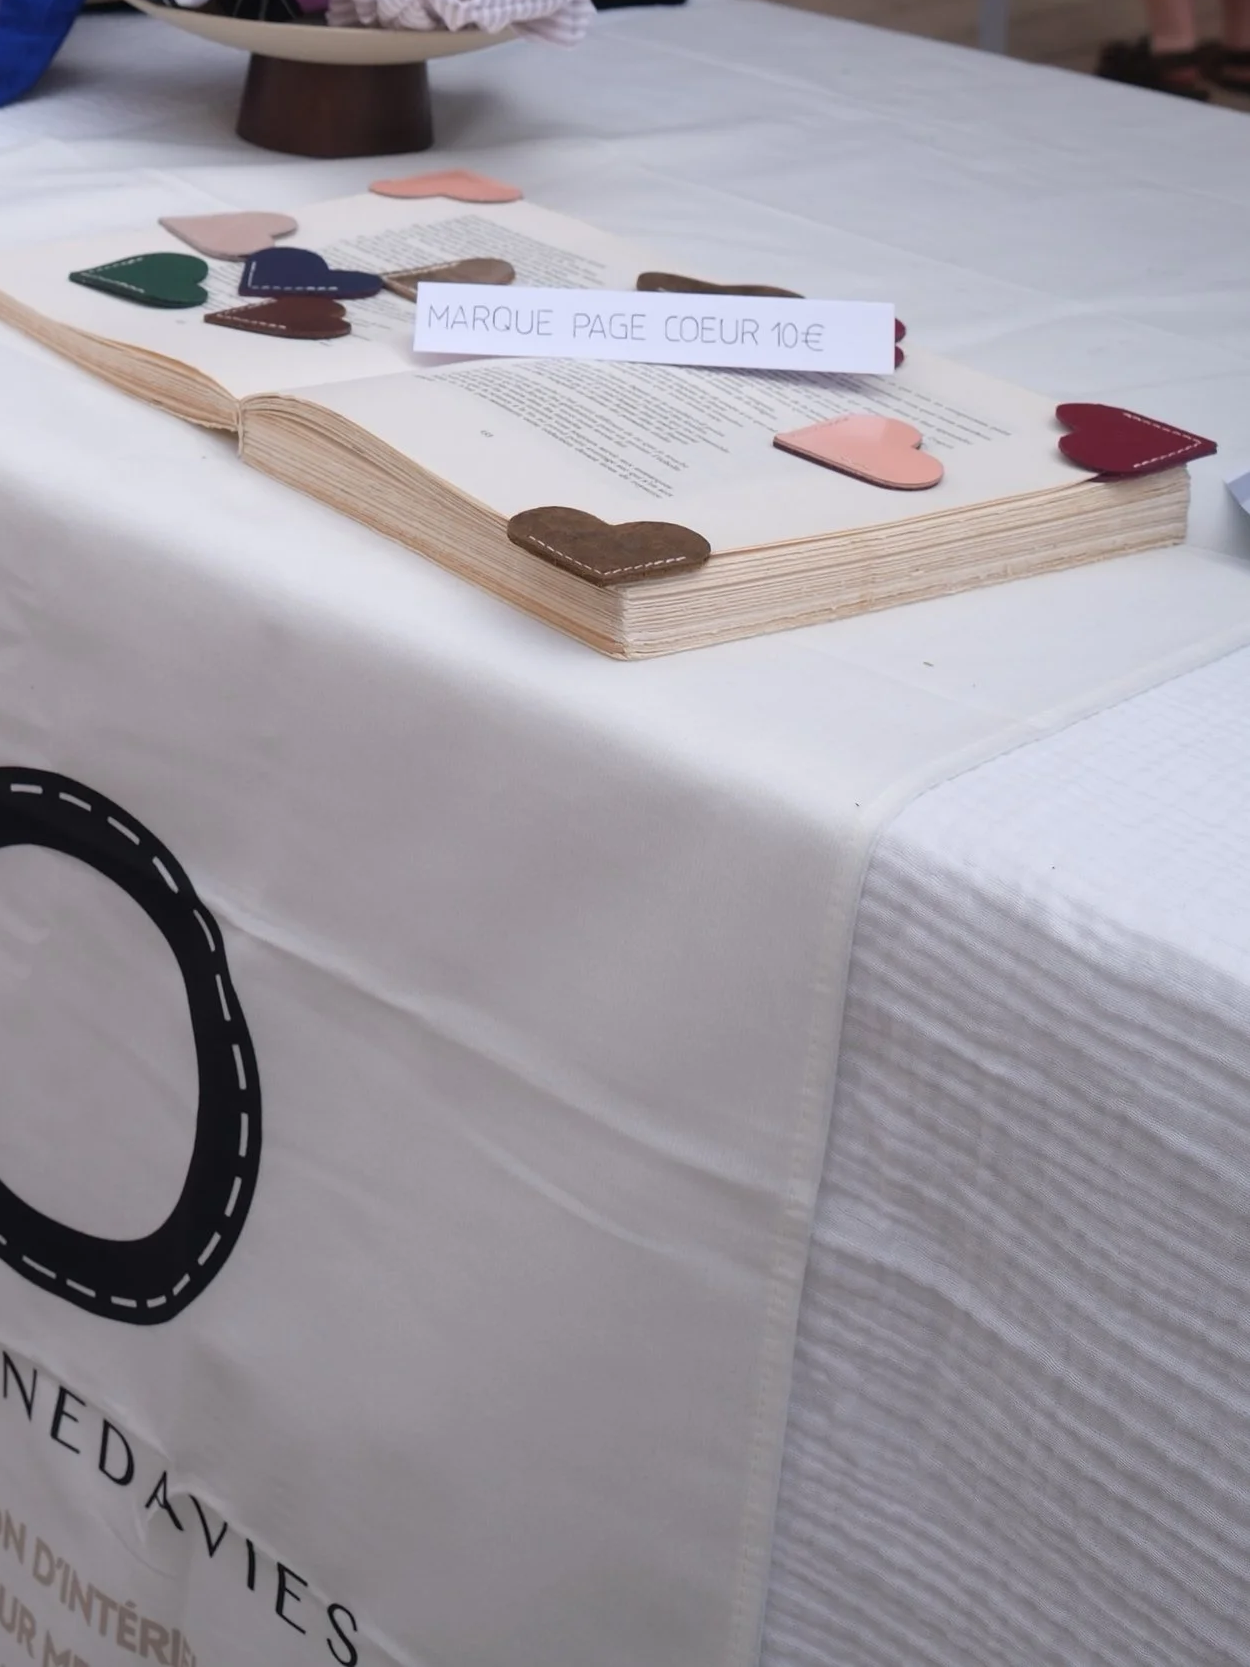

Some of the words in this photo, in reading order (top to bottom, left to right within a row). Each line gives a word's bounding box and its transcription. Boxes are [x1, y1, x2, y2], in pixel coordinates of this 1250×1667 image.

[428, 304, 553, 337] MARQUE
[572, 312, 647, 341] PAGE
[664, 315, 760, 347] COEUR
[770, 321, 826, 352] 10€
